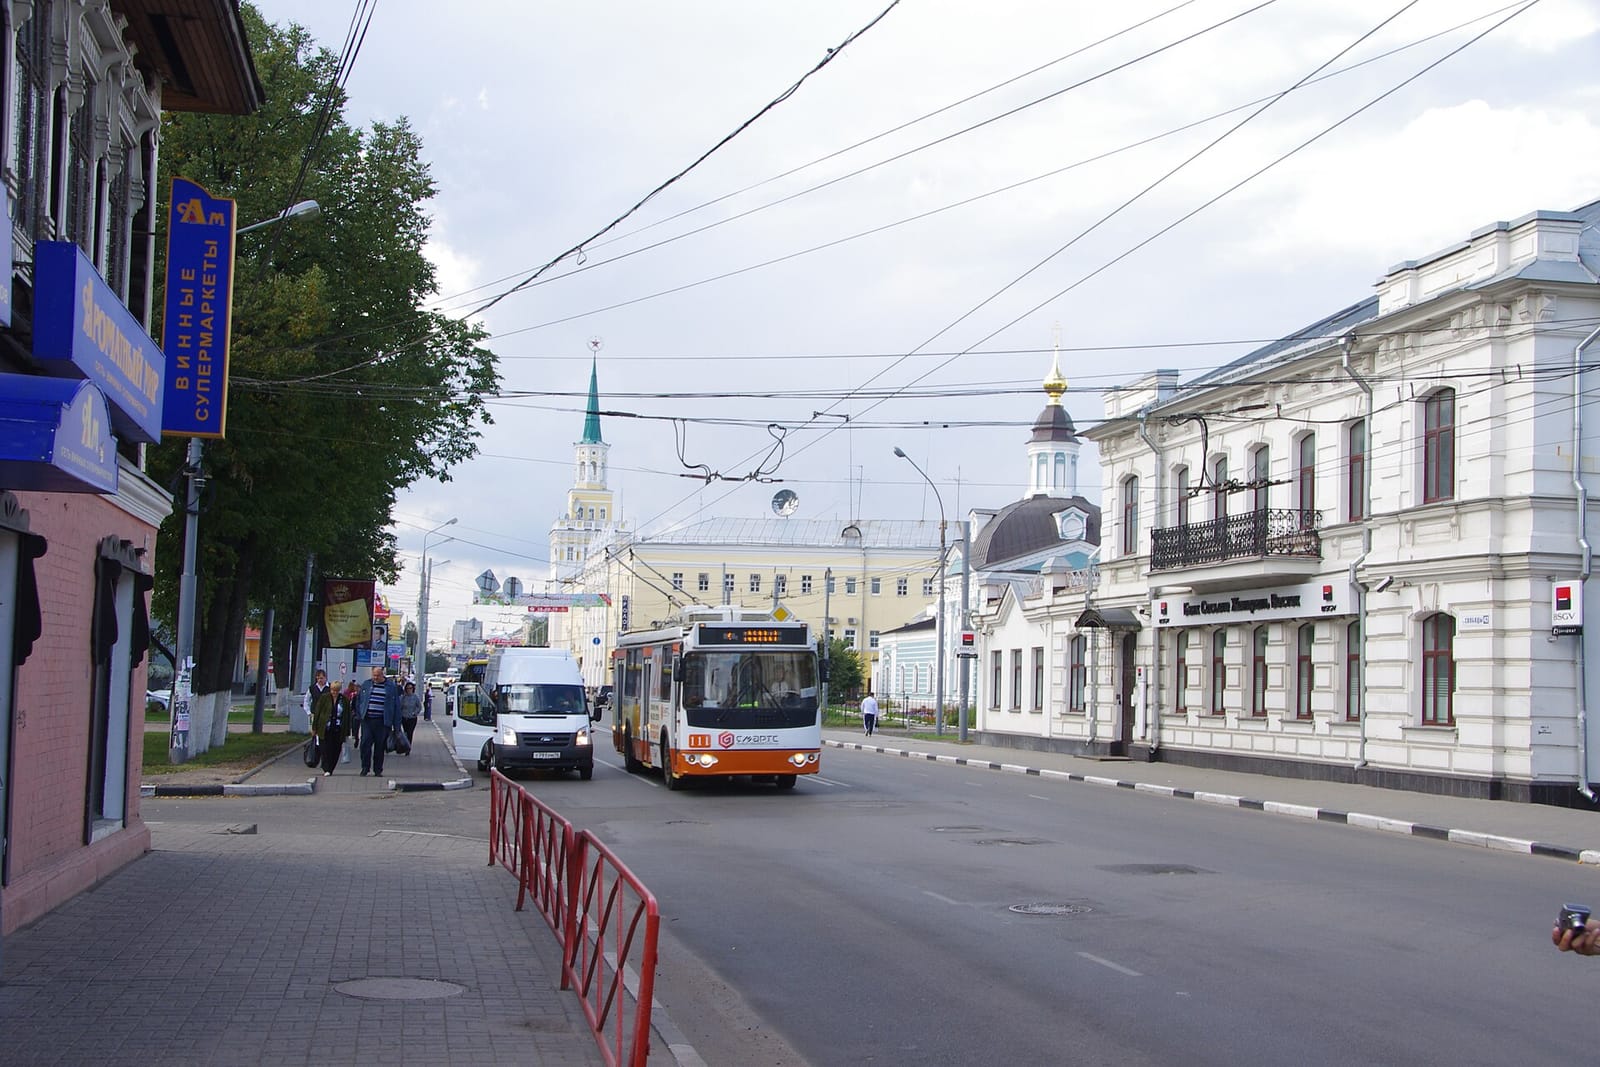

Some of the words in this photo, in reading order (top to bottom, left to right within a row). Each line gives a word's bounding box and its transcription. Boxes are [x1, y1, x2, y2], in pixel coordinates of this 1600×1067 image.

[176, 268, 195, 390] ВИННЫЕ
[196, 239, 219, 421] СУПЕРМАРКЕТЫ
[690, 735, 710, 746] 111
